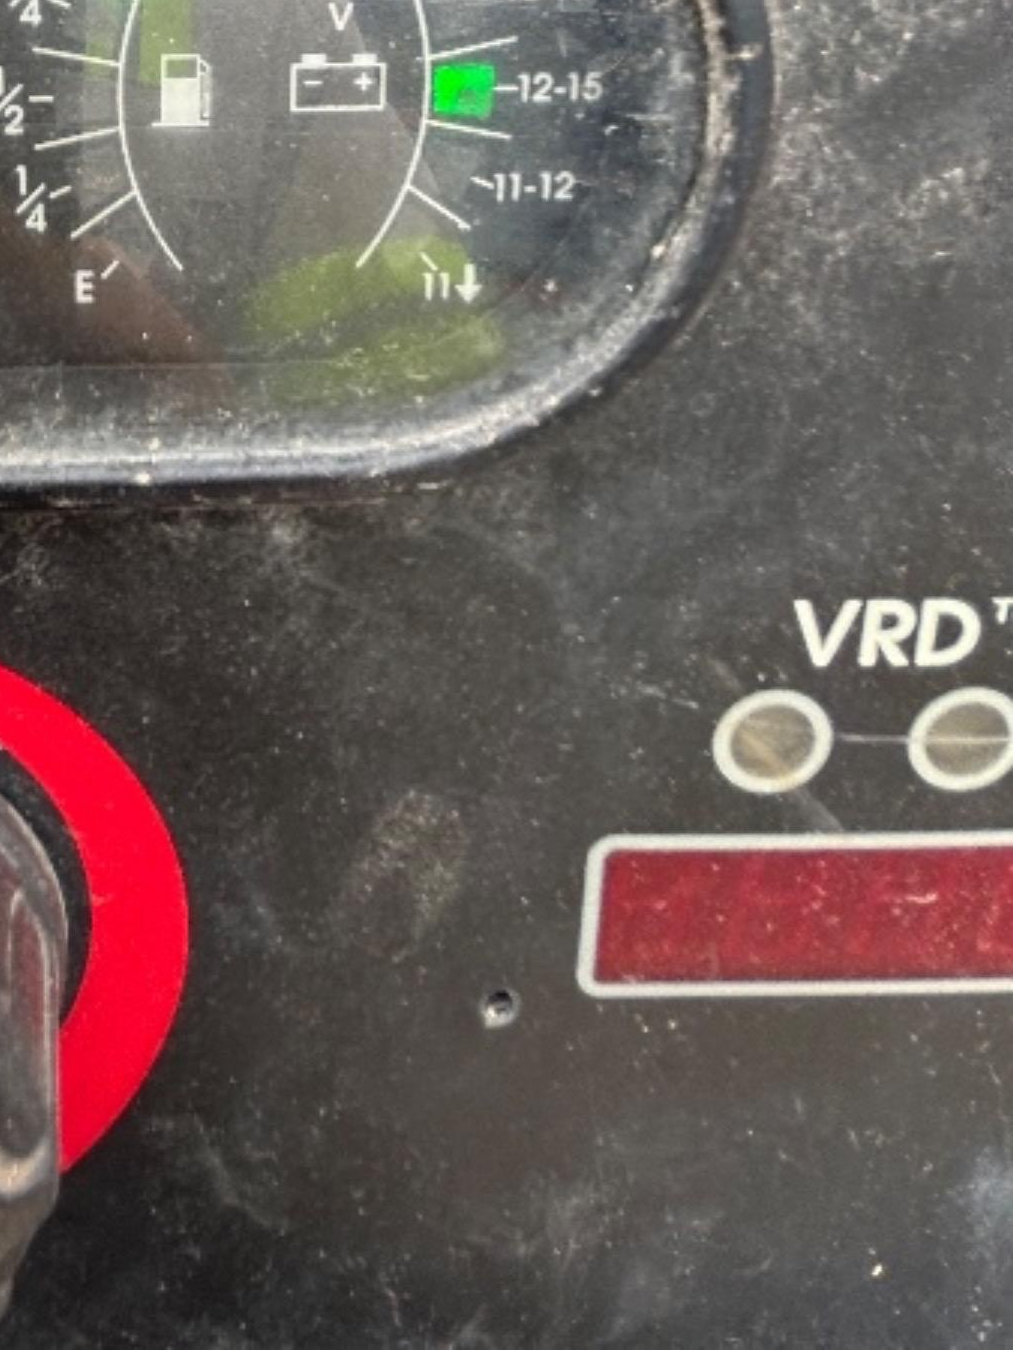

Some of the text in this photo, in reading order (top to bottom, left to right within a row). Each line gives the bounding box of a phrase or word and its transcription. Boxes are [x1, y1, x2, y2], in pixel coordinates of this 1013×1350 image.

[329, 2, 354, 32] V
[518, 72, 602, 102] 12-15
[494, 172, 576, 201] 11-12
[75, 270, 94, 303] E
[423, 271, 450, 300] 11
